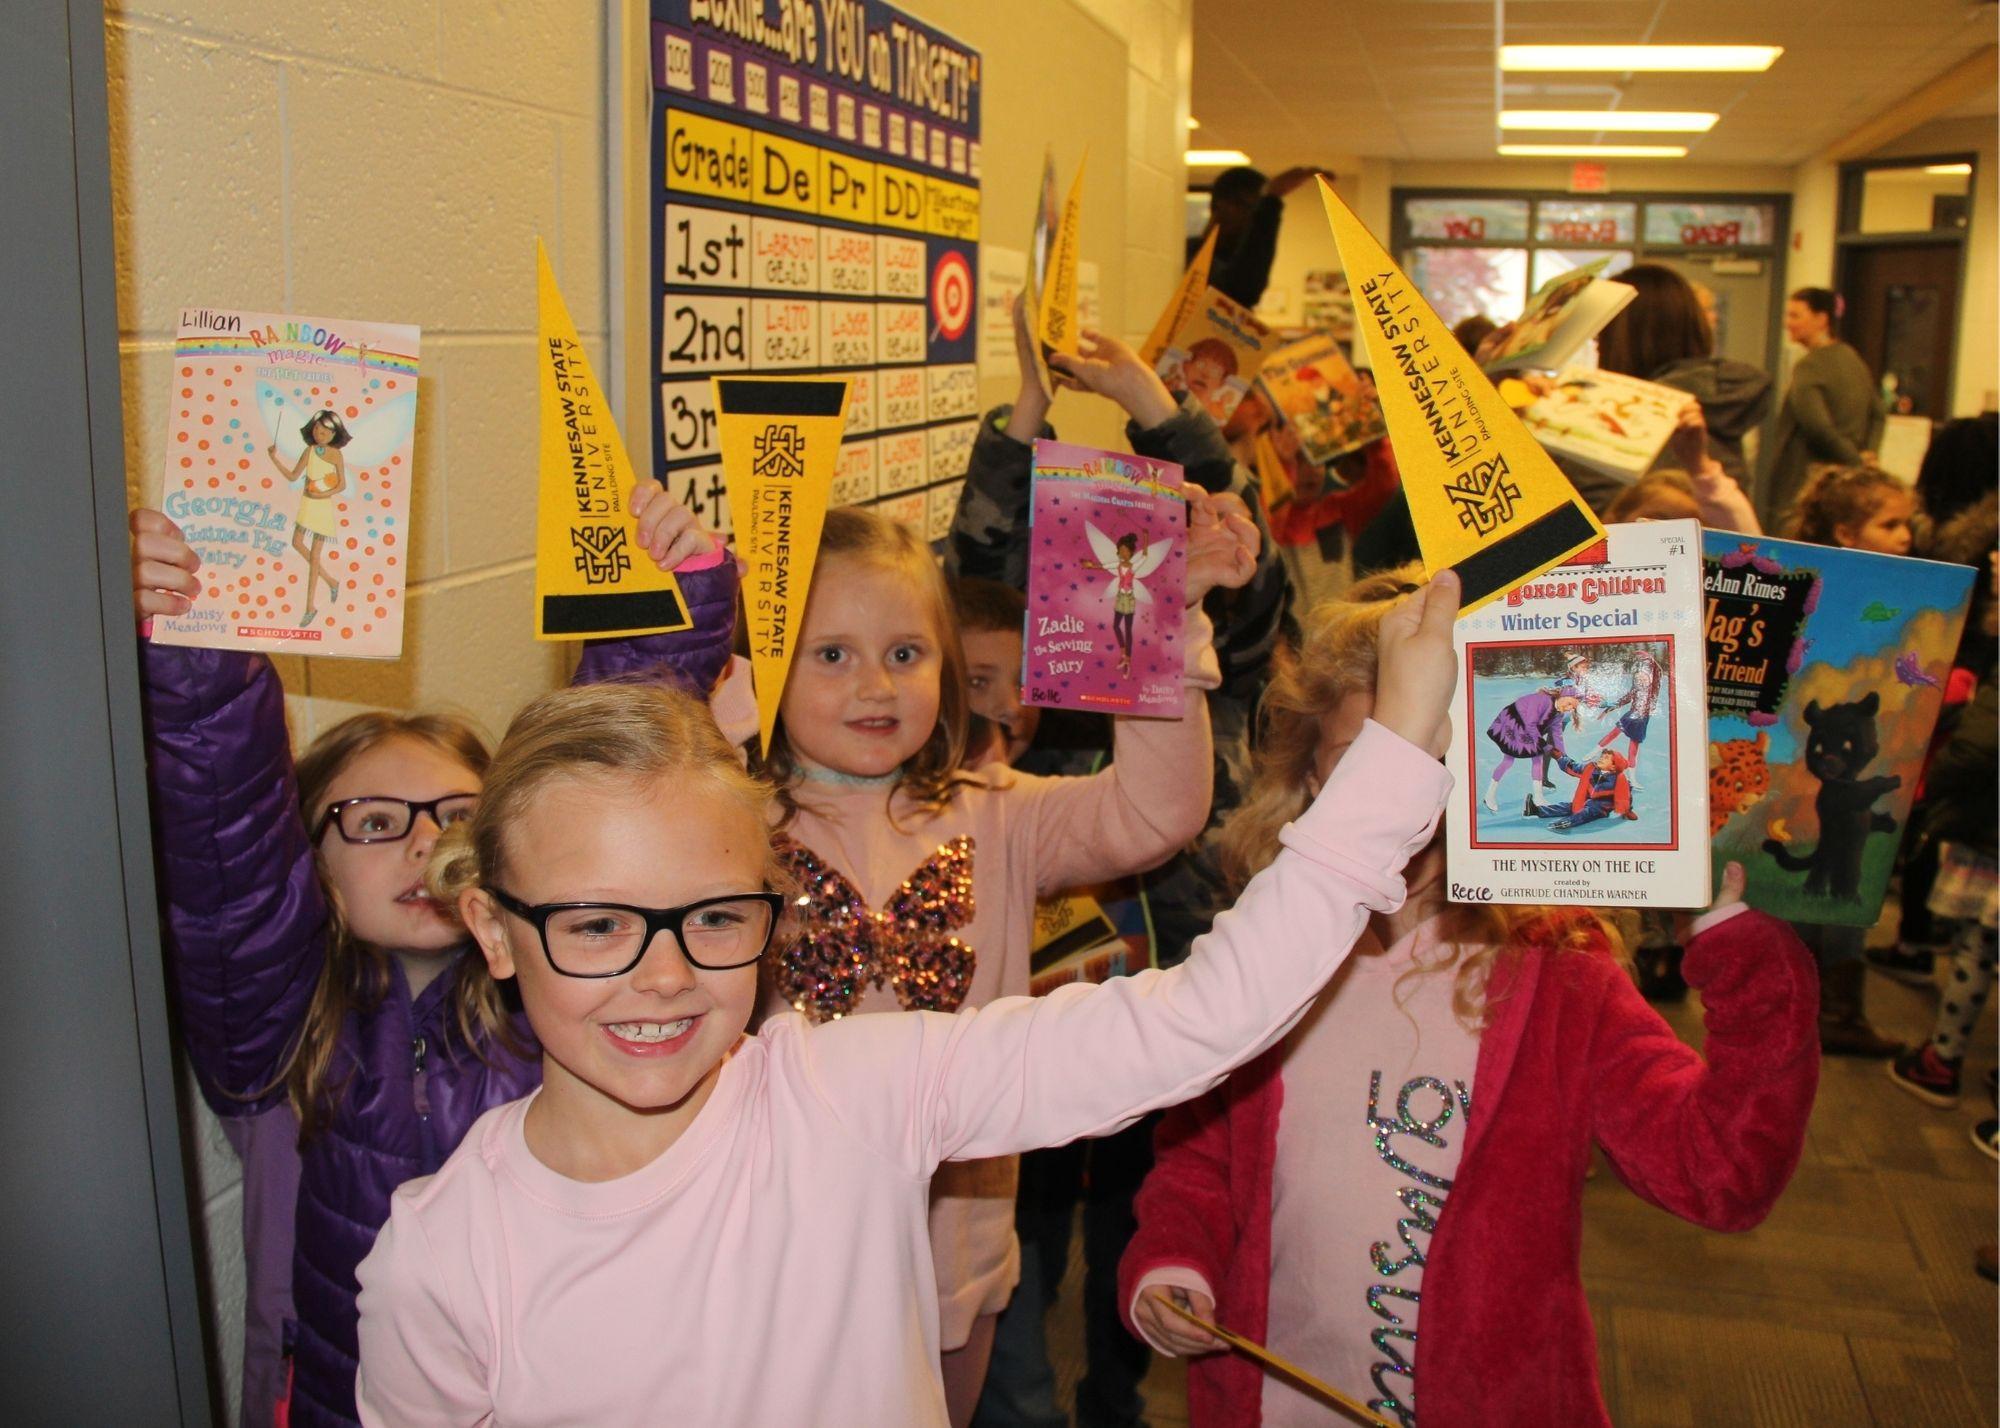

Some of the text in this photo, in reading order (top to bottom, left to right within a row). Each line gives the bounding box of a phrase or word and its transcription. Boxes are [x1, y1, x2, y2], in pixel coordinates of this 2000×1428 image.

[670, 128, 749, 188] Grade
[763, 146, 810, 202] De
[829, 160, 866, 210] Pr
[884, 175, 921, 219] DD
[676, 219, 744, 280] 1st
[182, 309, 241, 333] Lillian
[669, 306, 746, 364] 2nd
[1360, 277, 1462, 464] KENNESAW STATE
[1377, 270, 1480, 453] UNIVERSITY
[669, 396, 718, 451] 3r
[1449, 366, 1491, 442] PAULDING SITE
[549, 337, 592, 513] KENNESAW STATE
[564, 339, 610, 514] UNIVERSITY
[602, 443, 621, 513] PAULDING SITE
[165, 490, 288, 531] Georgia
[751, 489, 760, 536] PAULDING
[252, 528, 288, 558] Pig
[1660, 536, 1686, 544] SPECIAL
[1669, 544, 1686, 556] #1
[755, 490, 777, 658] UNIVERSITY
[770, 490, 793, 659] KENNESAW STATE
[1581, 575, 1668, 605] Children
[1704, 570, 1787, 601] eAnn Rimes
[249, 628, 321, 640] SCHOLASTIC
[1038, 614, 1085, 637] Zadie
[1501, 608, 1639, 633] Winter Special
[1048, 639, 1094, 654] Sewing
[1048, 659, 1085, 676] Fairy
[1713, 653, 1769, 685] Friend
[1492, 859, 1656, 874] THE MYSTERY ON THE ICE
[1554, 878, 1591, 887] created by
[1451, 883, 1494, 901] Reece
[1500, 887, 1648, 900] GERTRUDE CHANDLER WARNER
